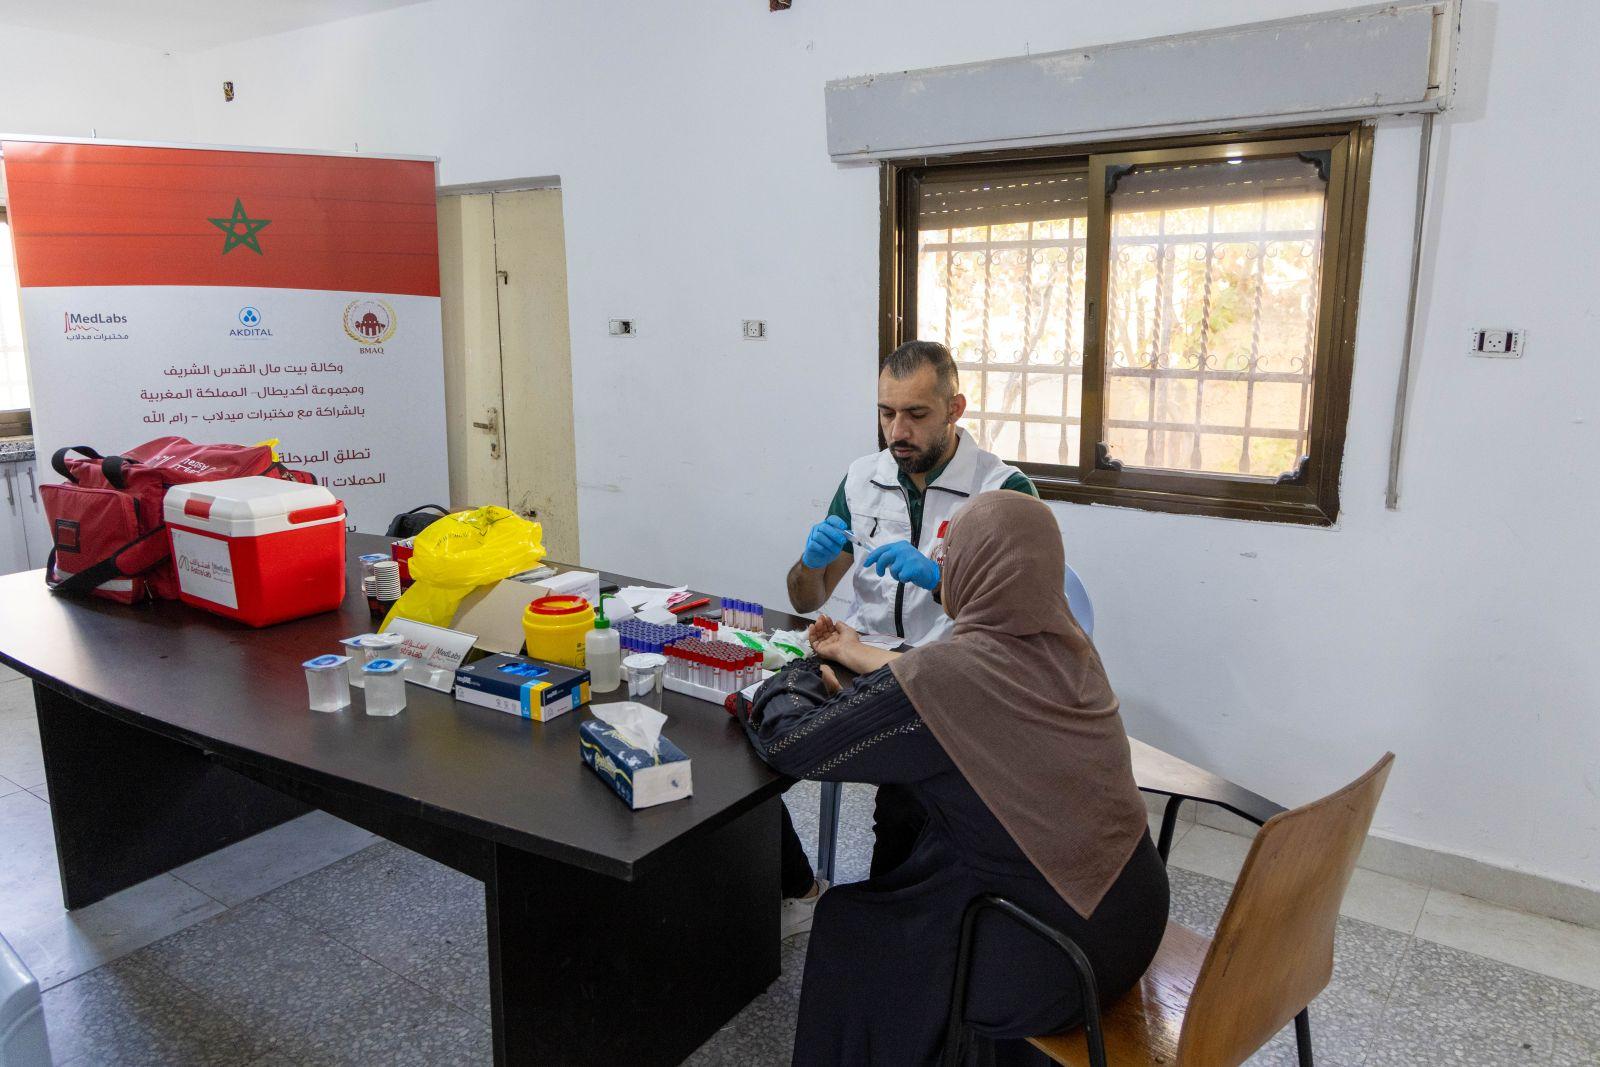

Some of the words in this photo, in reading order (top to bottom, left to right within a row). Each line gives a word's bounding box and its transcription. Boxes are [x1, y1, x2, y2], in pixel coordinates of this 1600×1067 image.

[70, 313, 128, 324] MedLabs
[66, 333, 92, 341] مدلاب
[93, 333, 129, 341] مختبرات
[229, 328, 273, 337] AKDITAL
[359, 347, 385, 355] BMAQ
[163, 363, 210, 378] الشريف
[213, 364, 256, 377] القدس
[259, 363, 281, 376] مال
[284, 364, 307, 375] بيت
[310, 363, 343, 375] وكالة
[140, 388, 192, 403] المغربية
[196, 387, 247, 398] المملكة
[311, 385, 364, 397] ومجموعة
[202, 411, 244, 423] ميدلاب
[247, 409, 294, 421] مختبرات
[297, 409, 313, 420] مع
[315, 404, 365, 418] بالشراكة
[169, 412, 188, 425] رام
[279, 450, 329, 466] المرحلة
[333, 447, 371, 464] تطلق
[332, 473, 386, 488] الحملات
[400, 647, 423, 659] straLab
